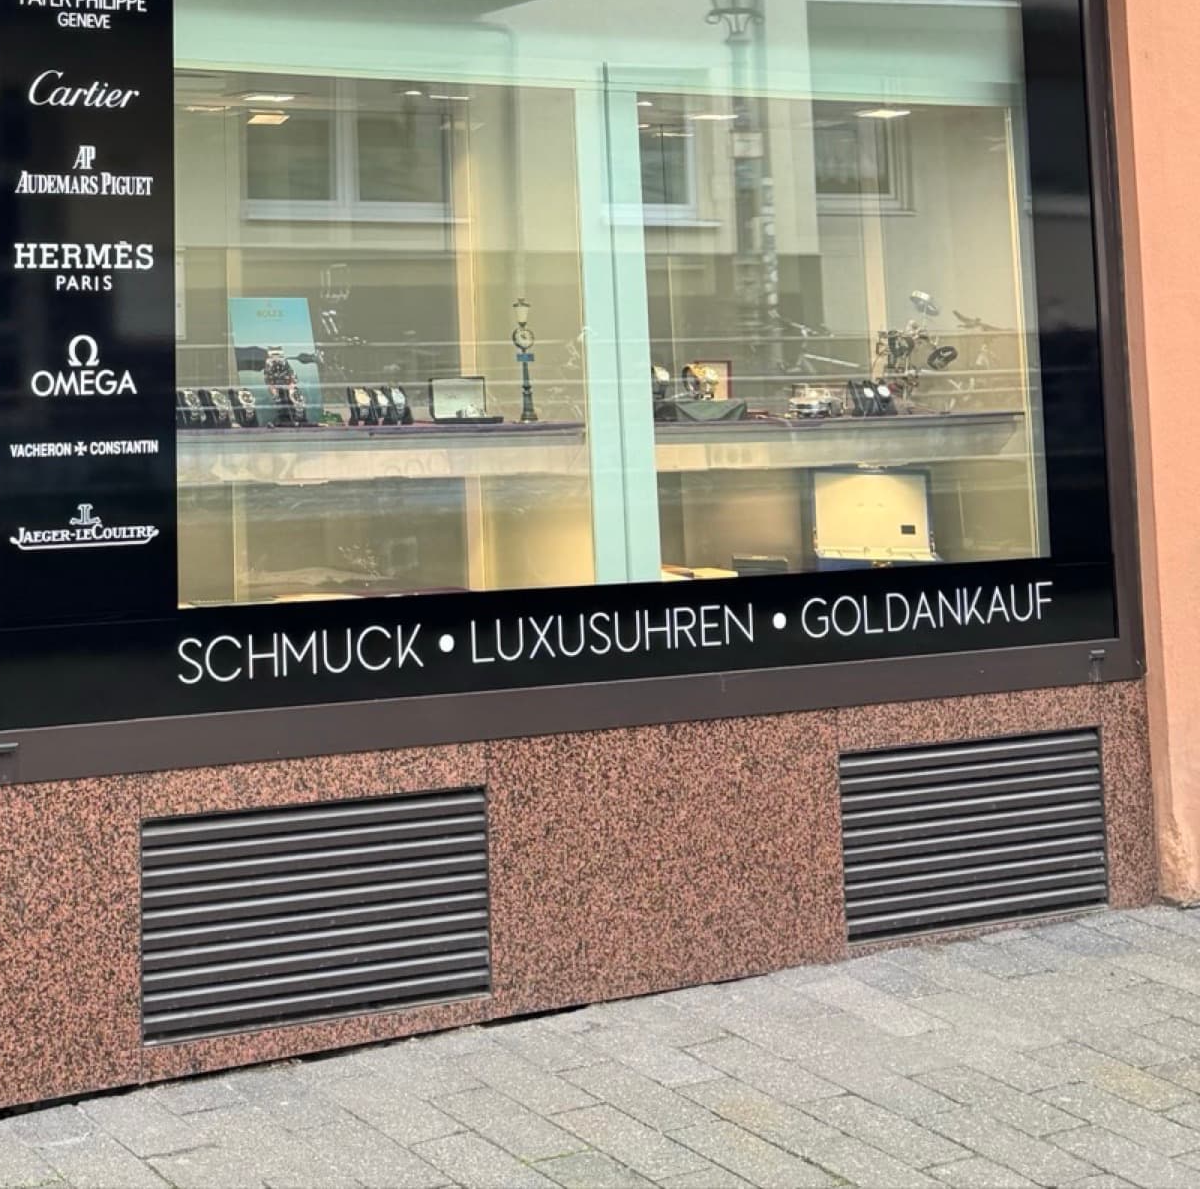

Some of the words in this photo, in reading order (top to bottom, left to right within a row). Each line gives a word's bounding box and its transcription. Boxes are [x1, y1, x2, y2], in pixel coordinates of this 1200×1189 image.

[28, 69, 140, 109] Cartier
[72, 145, 97, 170] AP
[14, 171, 99, 196] AUDEMARS
[100, 172, 154, 196] PIGUET
[13, 241, 154, 270] HERMÈS
[56, 274, 113, 292] PARIS
[30, 369, 138, 397] OMEGA
[9, 441, 73, 458] VACHERON
[89, 439, 159, 456] CONSTANTIN
[177, 623, 426, 685] SCHMUCK
[469, 602, 755, 664] LUXUSUHREN
[800, 581, 1054, 639] GOLDANKAUF
